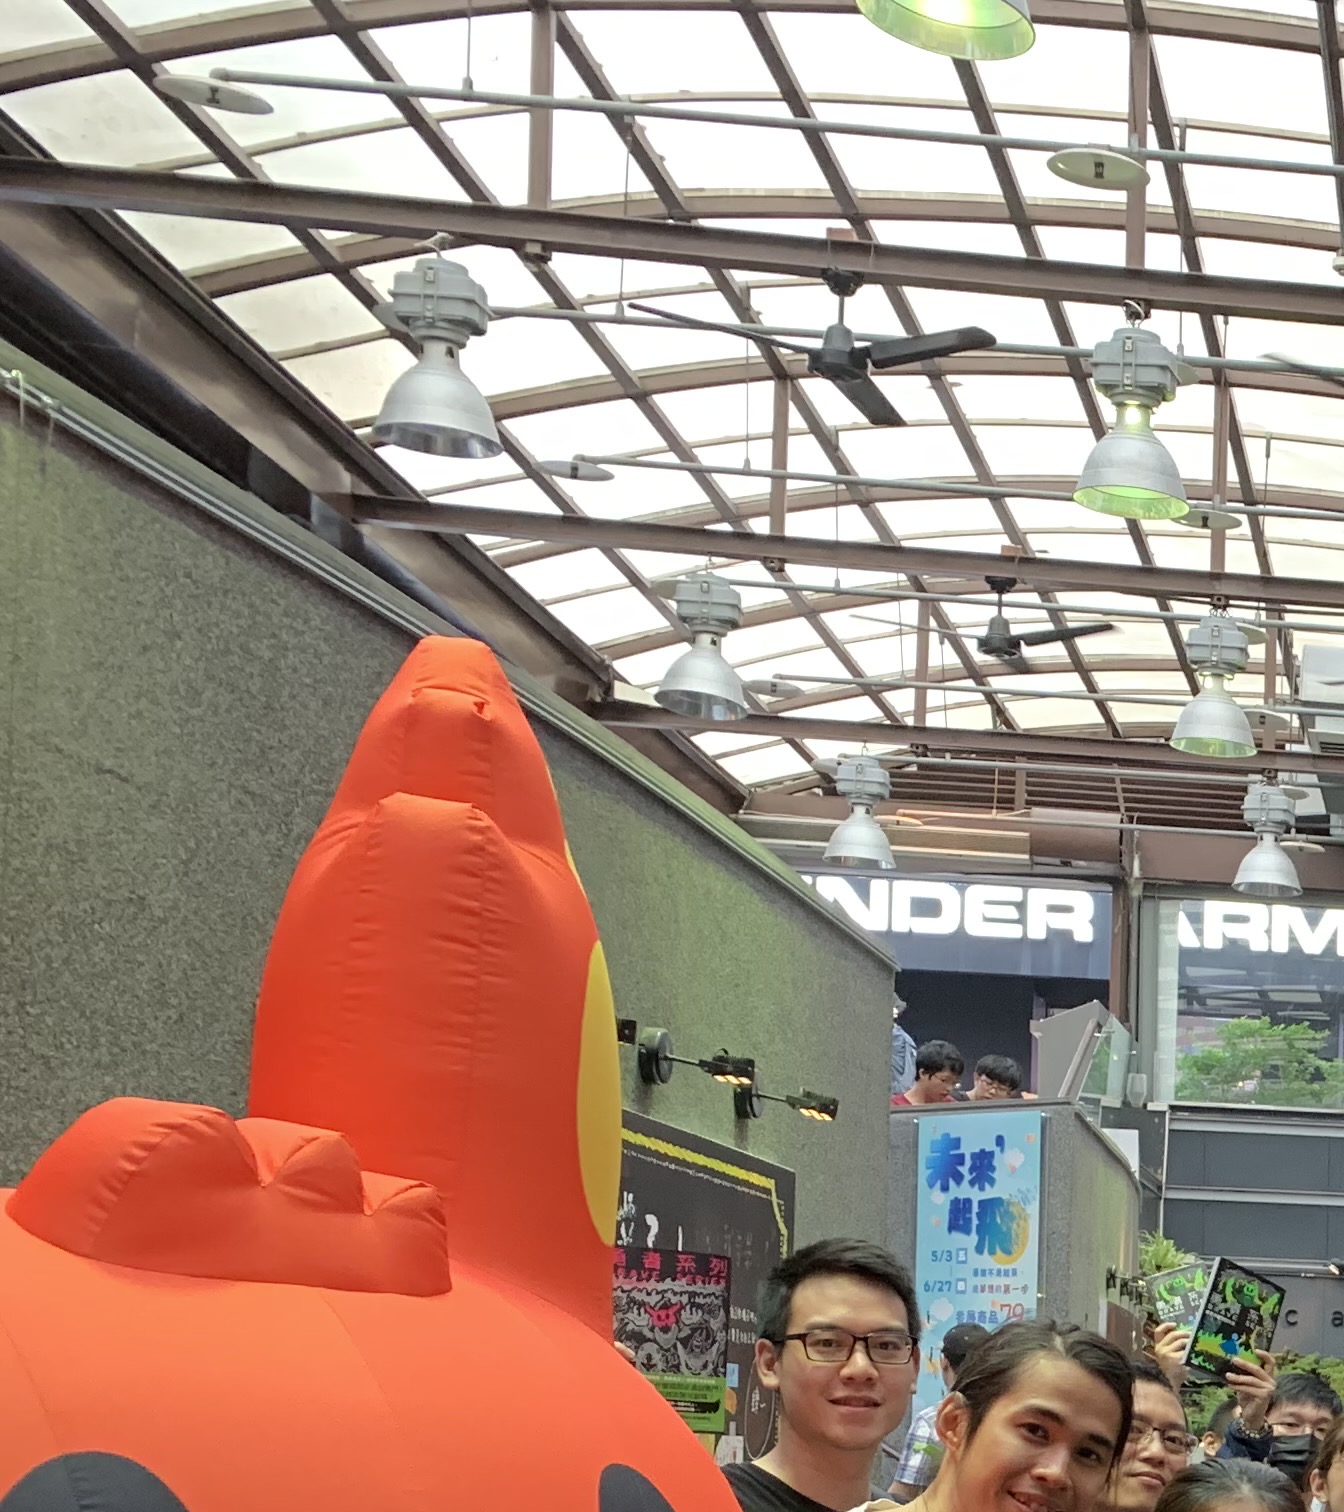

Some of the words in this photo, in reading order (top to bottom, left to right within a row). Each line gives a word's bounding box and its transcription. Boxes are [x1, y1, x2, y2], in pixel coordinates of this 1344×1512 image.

[803, 876, 1094, 942] NDER
[947, 1196, 1014, 1255] 起飛
[931, 1250, 952, 1262] 5/3
[924, 1280, 952, 1292] 6/27
